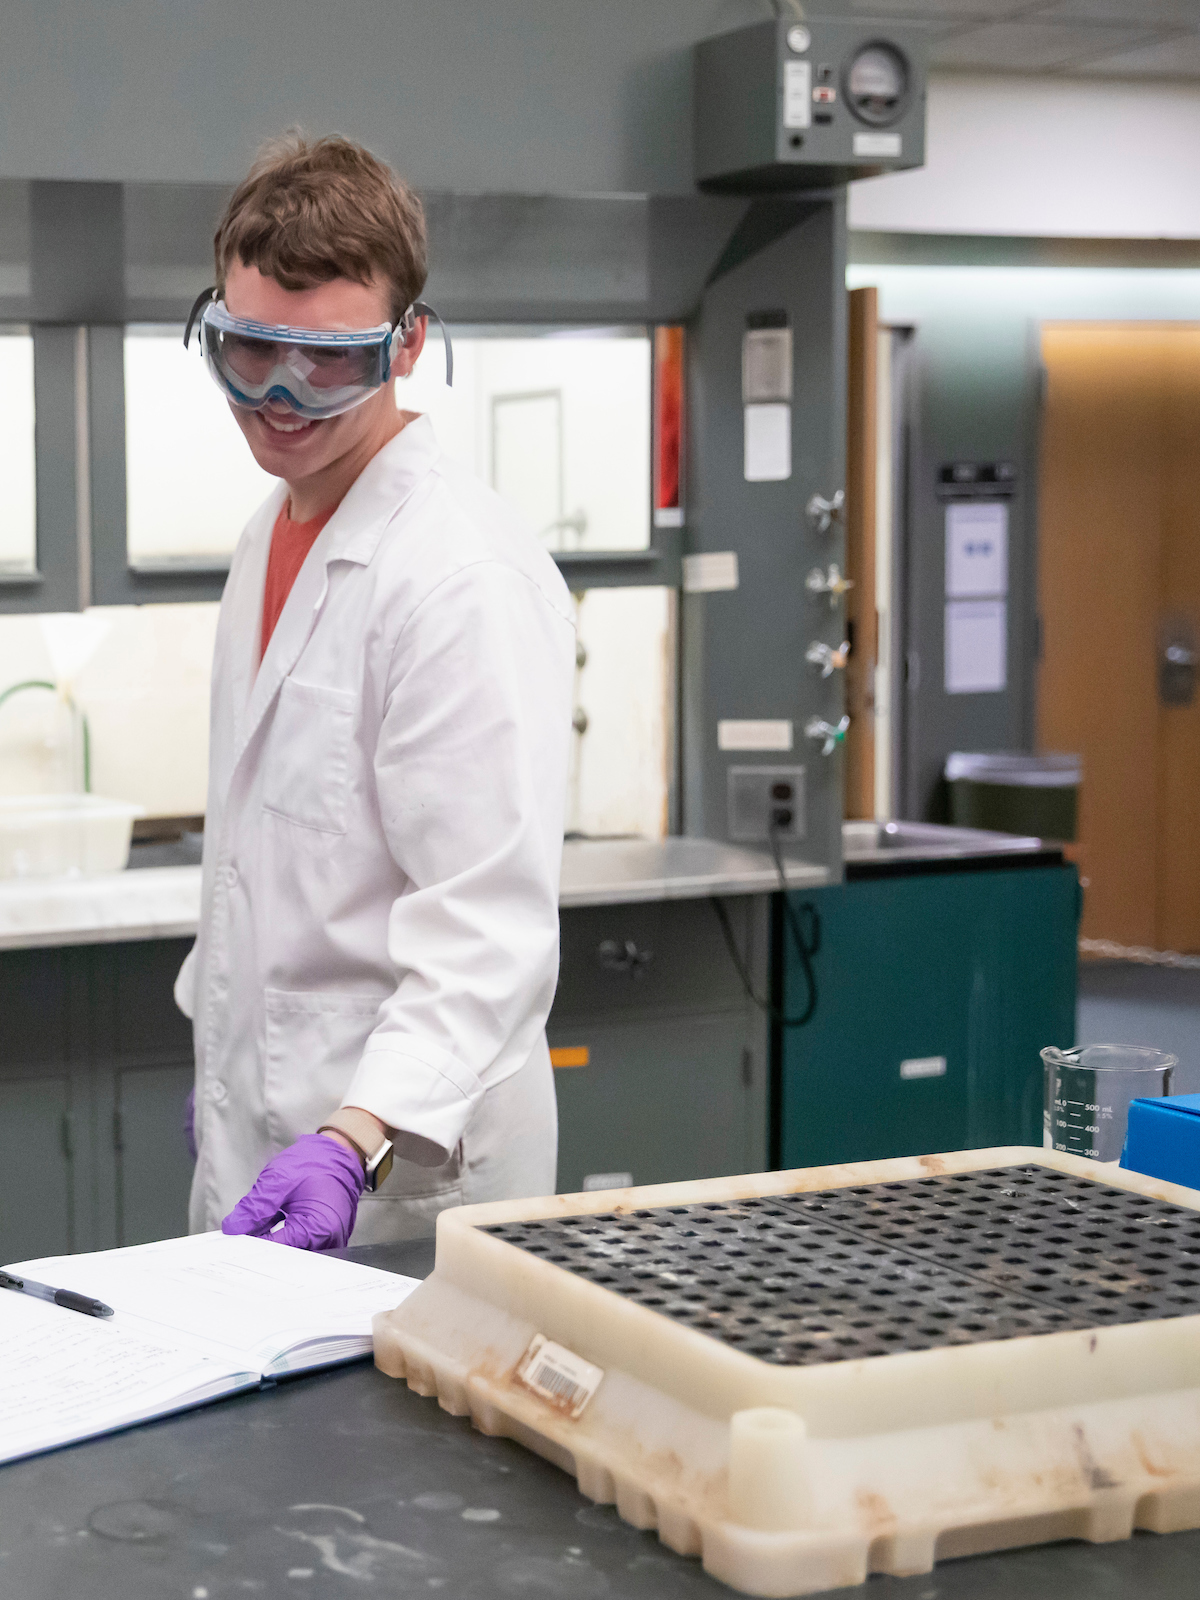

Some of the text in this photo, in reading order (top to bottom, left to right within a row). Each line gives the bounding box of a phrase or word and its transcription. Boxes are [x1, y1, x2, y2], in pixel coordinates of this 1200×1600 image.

[1084, 1104, 1100, 1112] 500
[1056, 1119, 1067, 1128] 100
[1084, 1125, 1100, 1133] 400
[1055, 1143, 1066, 1151] 200
[1084, 1149, 1100, 1157] 300
